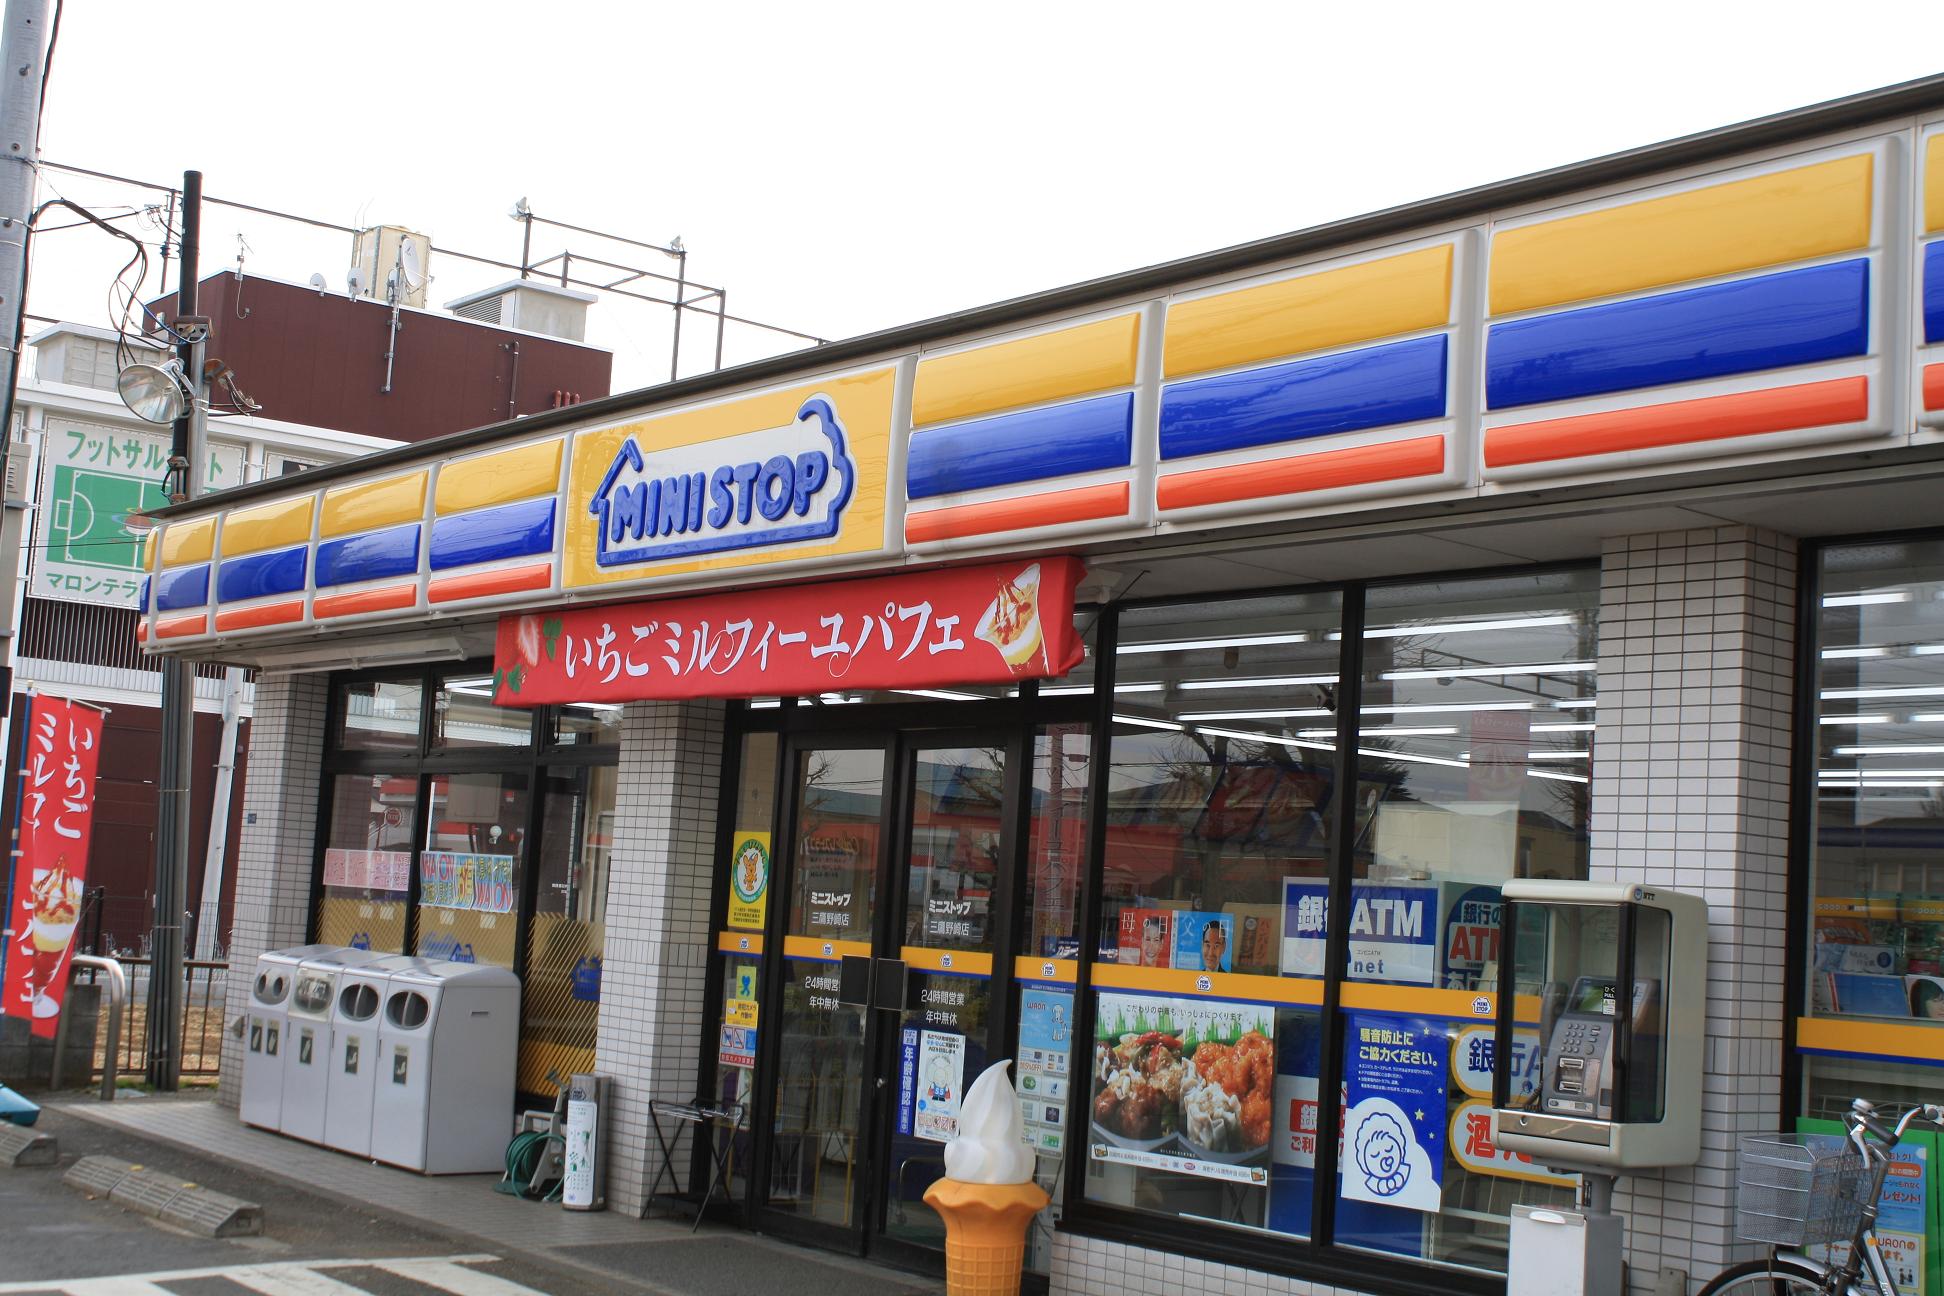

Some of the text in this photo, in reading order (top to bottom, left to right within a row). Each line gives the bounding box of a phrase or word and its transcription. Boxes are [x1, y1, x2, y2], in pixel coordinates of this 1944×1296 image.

[66, 430, 223, 482] フットサルト
[563, 600, 966, 684] いちごミルフィーユパフェ
[54, 717, 94, 839] いちご
[810, 890, 851, 907] ミニストップ
[928, 899, 972, 916] ミニストップ
[1121, 911, 1169, 935] 母の日
[1181, 914, 1231, 939] 父の日
[804, 975, 841, 992] 24時間営
[808, 995, 841, 1012] 年中無休
[920, 988, 966, 1006] 24時間営業
[925, 1009, 959, 1026] 年中無休
[1360, 1027, 1414, 1046] 騒音防止に
[1359, 1045, 1438, 1067] ご協力ください。
